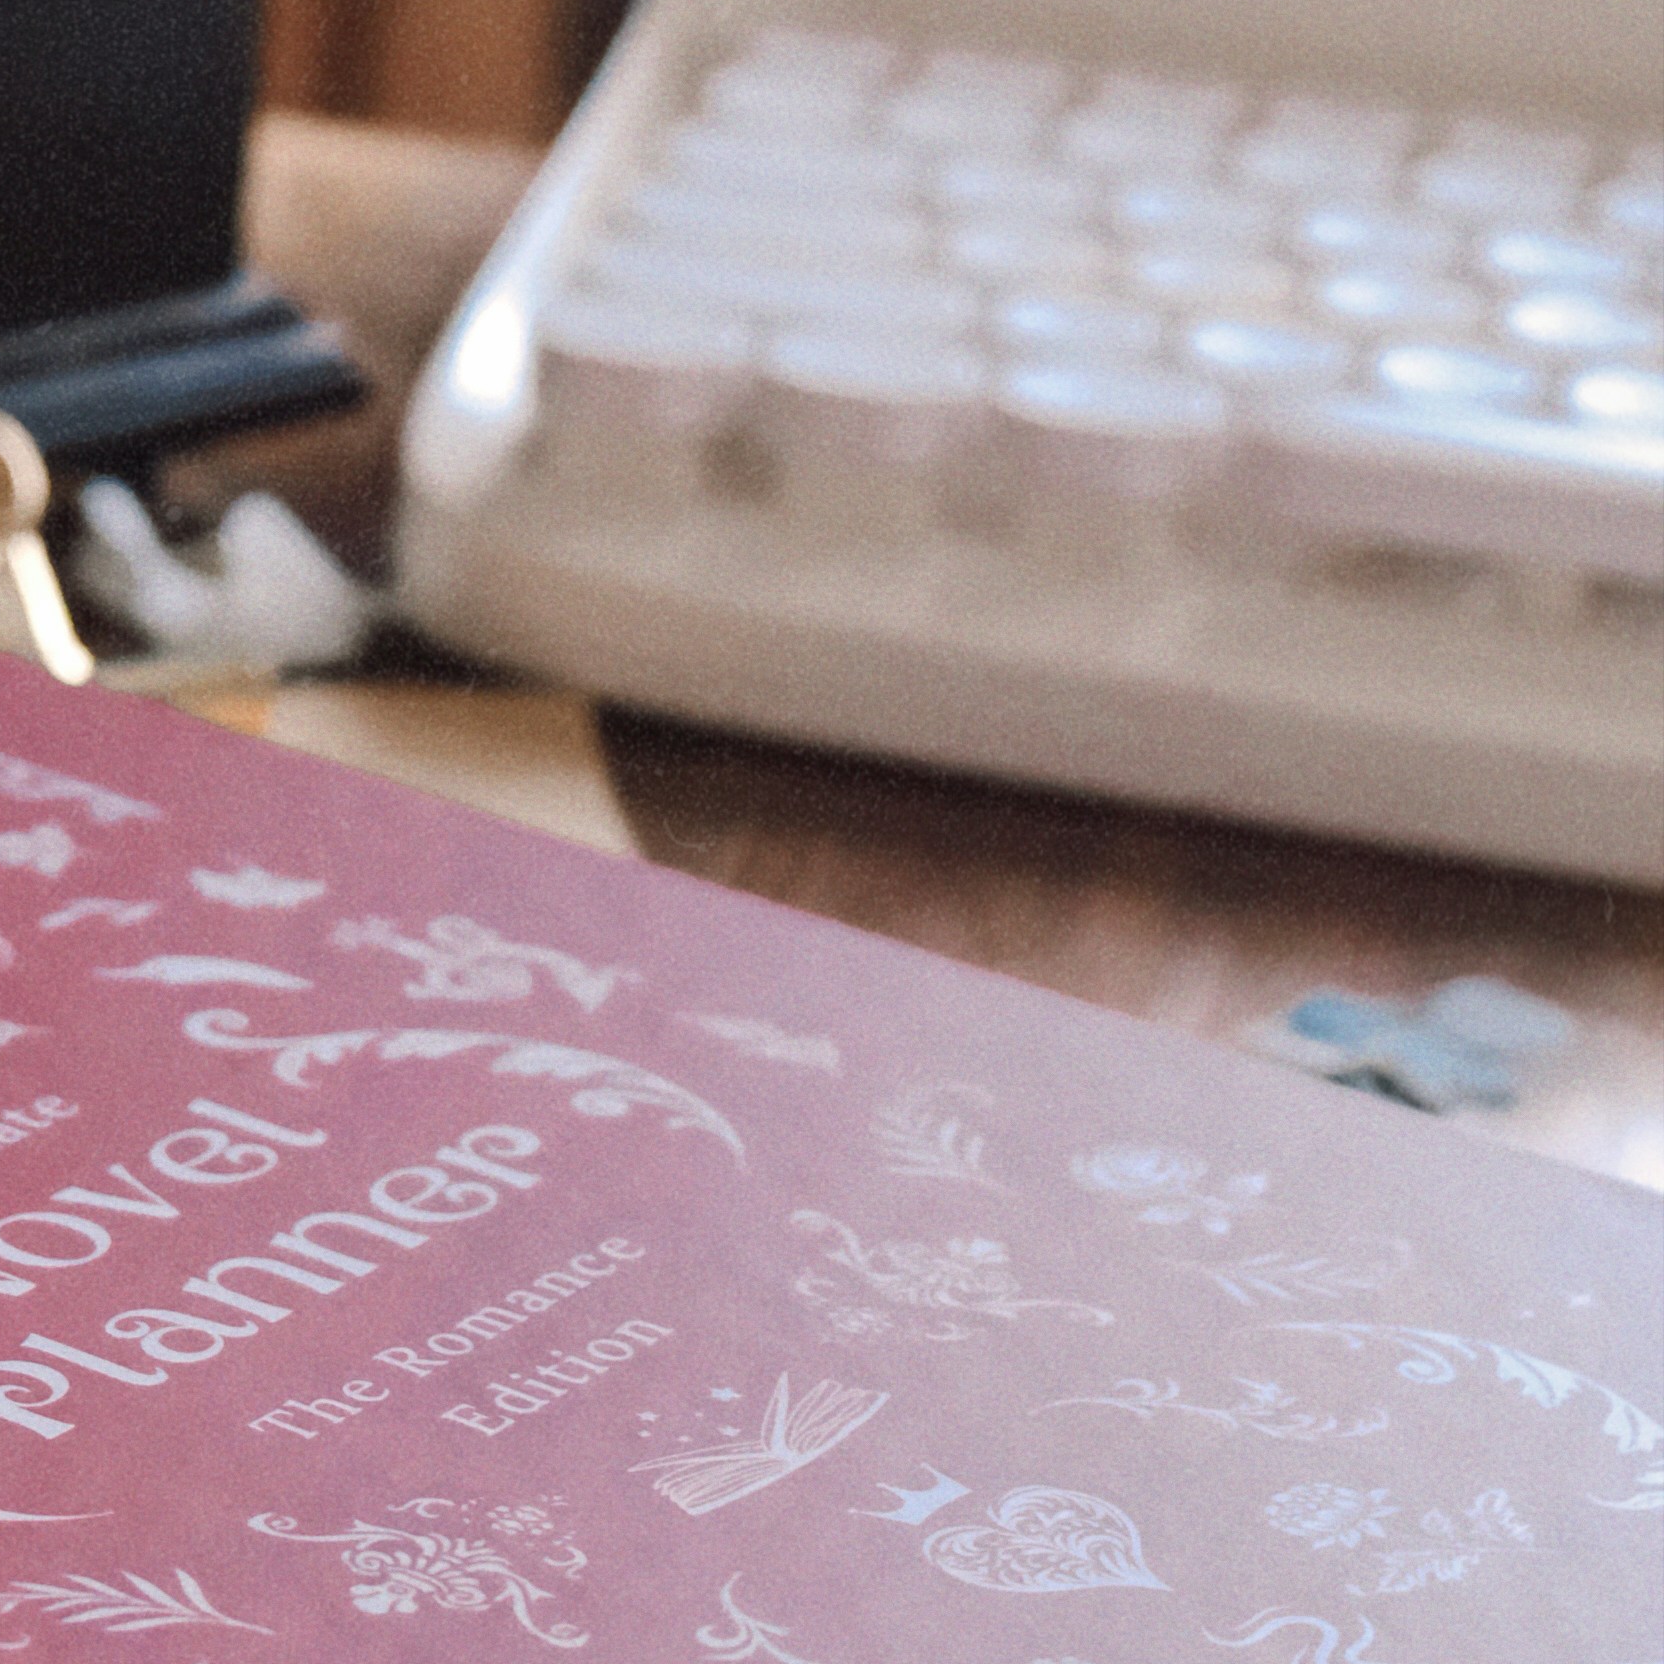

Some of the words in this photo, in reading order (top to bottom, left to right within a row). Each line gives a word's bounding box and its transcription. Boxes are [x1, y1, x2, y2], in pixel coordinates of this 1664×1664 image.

[248, 1373, 391, 1442] The
[372, 1233, 647, 1377] Romance
[440, 1313, 675, 1439] Edition
